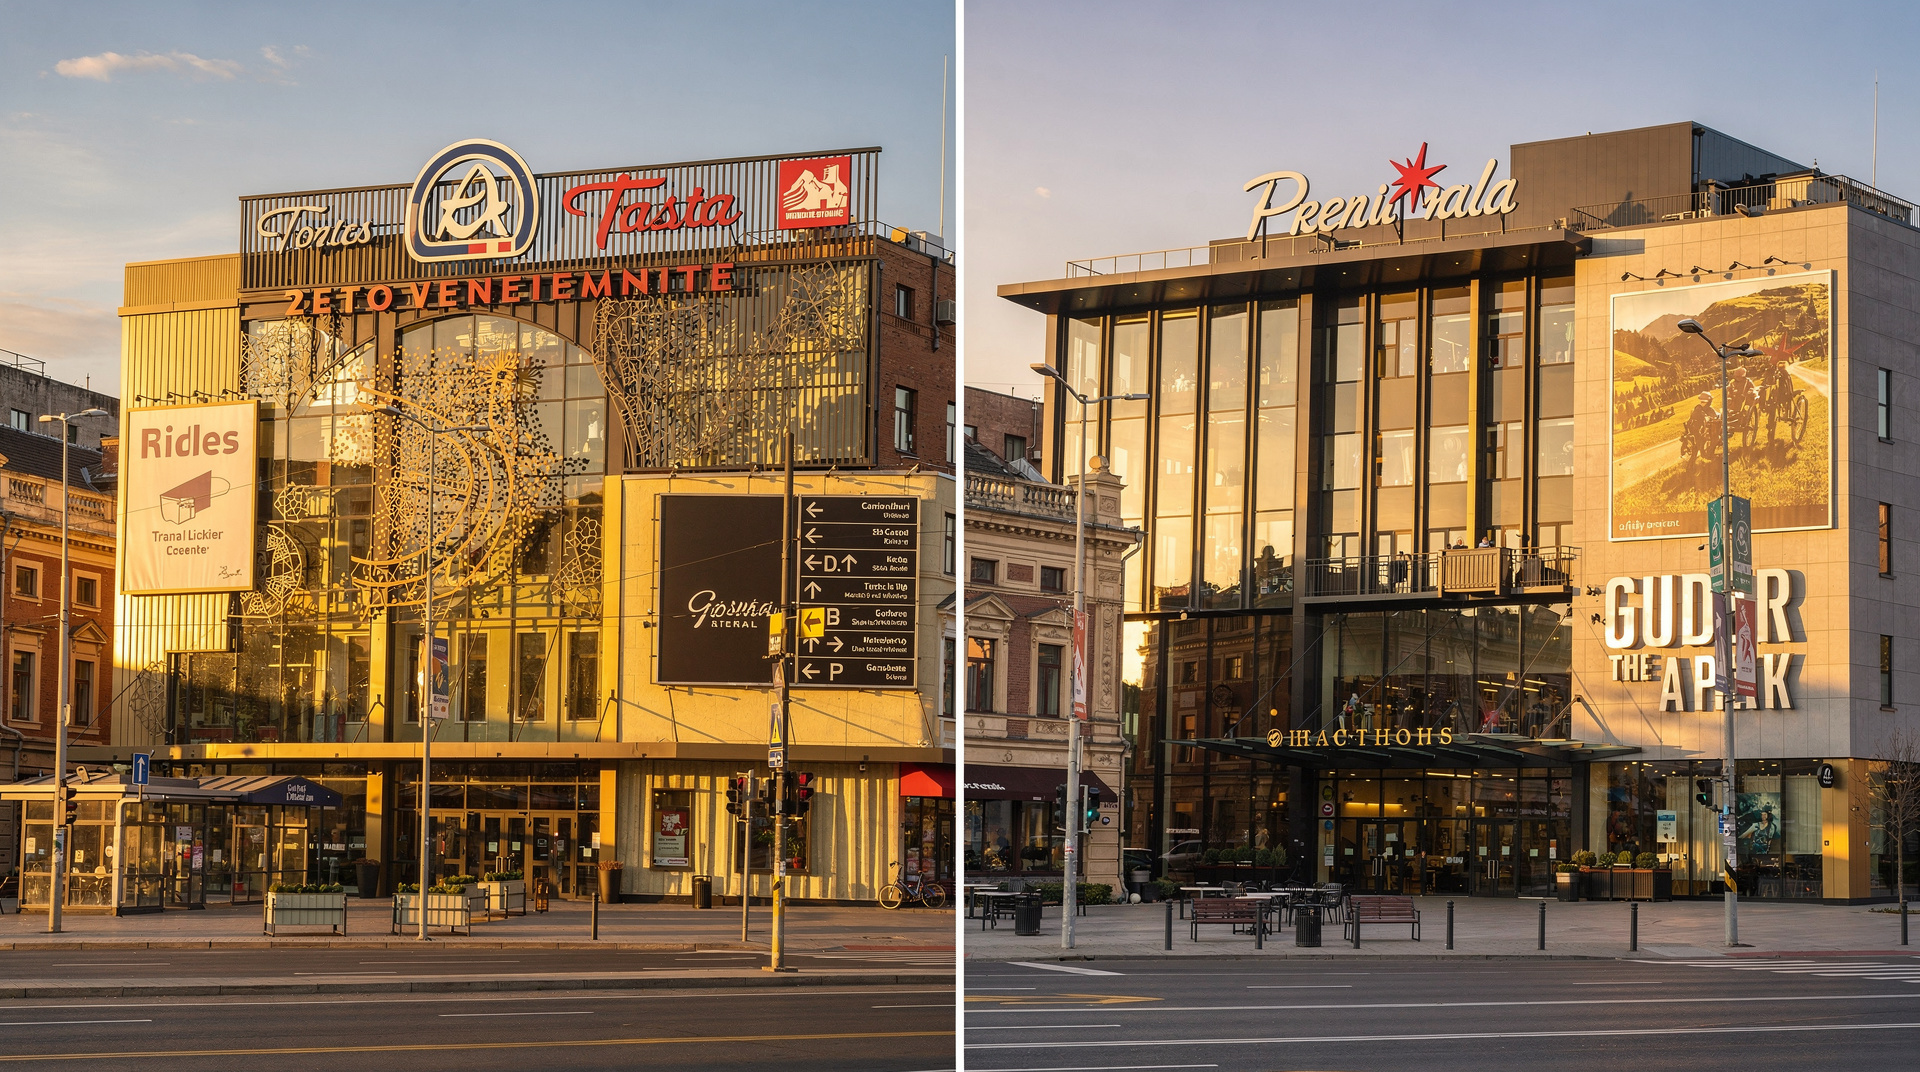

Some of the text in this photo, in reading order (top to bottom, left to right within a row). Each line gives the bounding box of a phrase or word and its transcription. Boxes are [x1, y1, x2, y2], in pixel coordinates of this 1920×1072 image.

[562, 173, 743, 250] Tasta
[141, 424, 240, 460] Ridles
[826, 607, 841, 626] B
[1605, 567, 1793, 650] GUDR
[829, 662, 844, 682] P
[1608, 653, 1653, 682] THE
